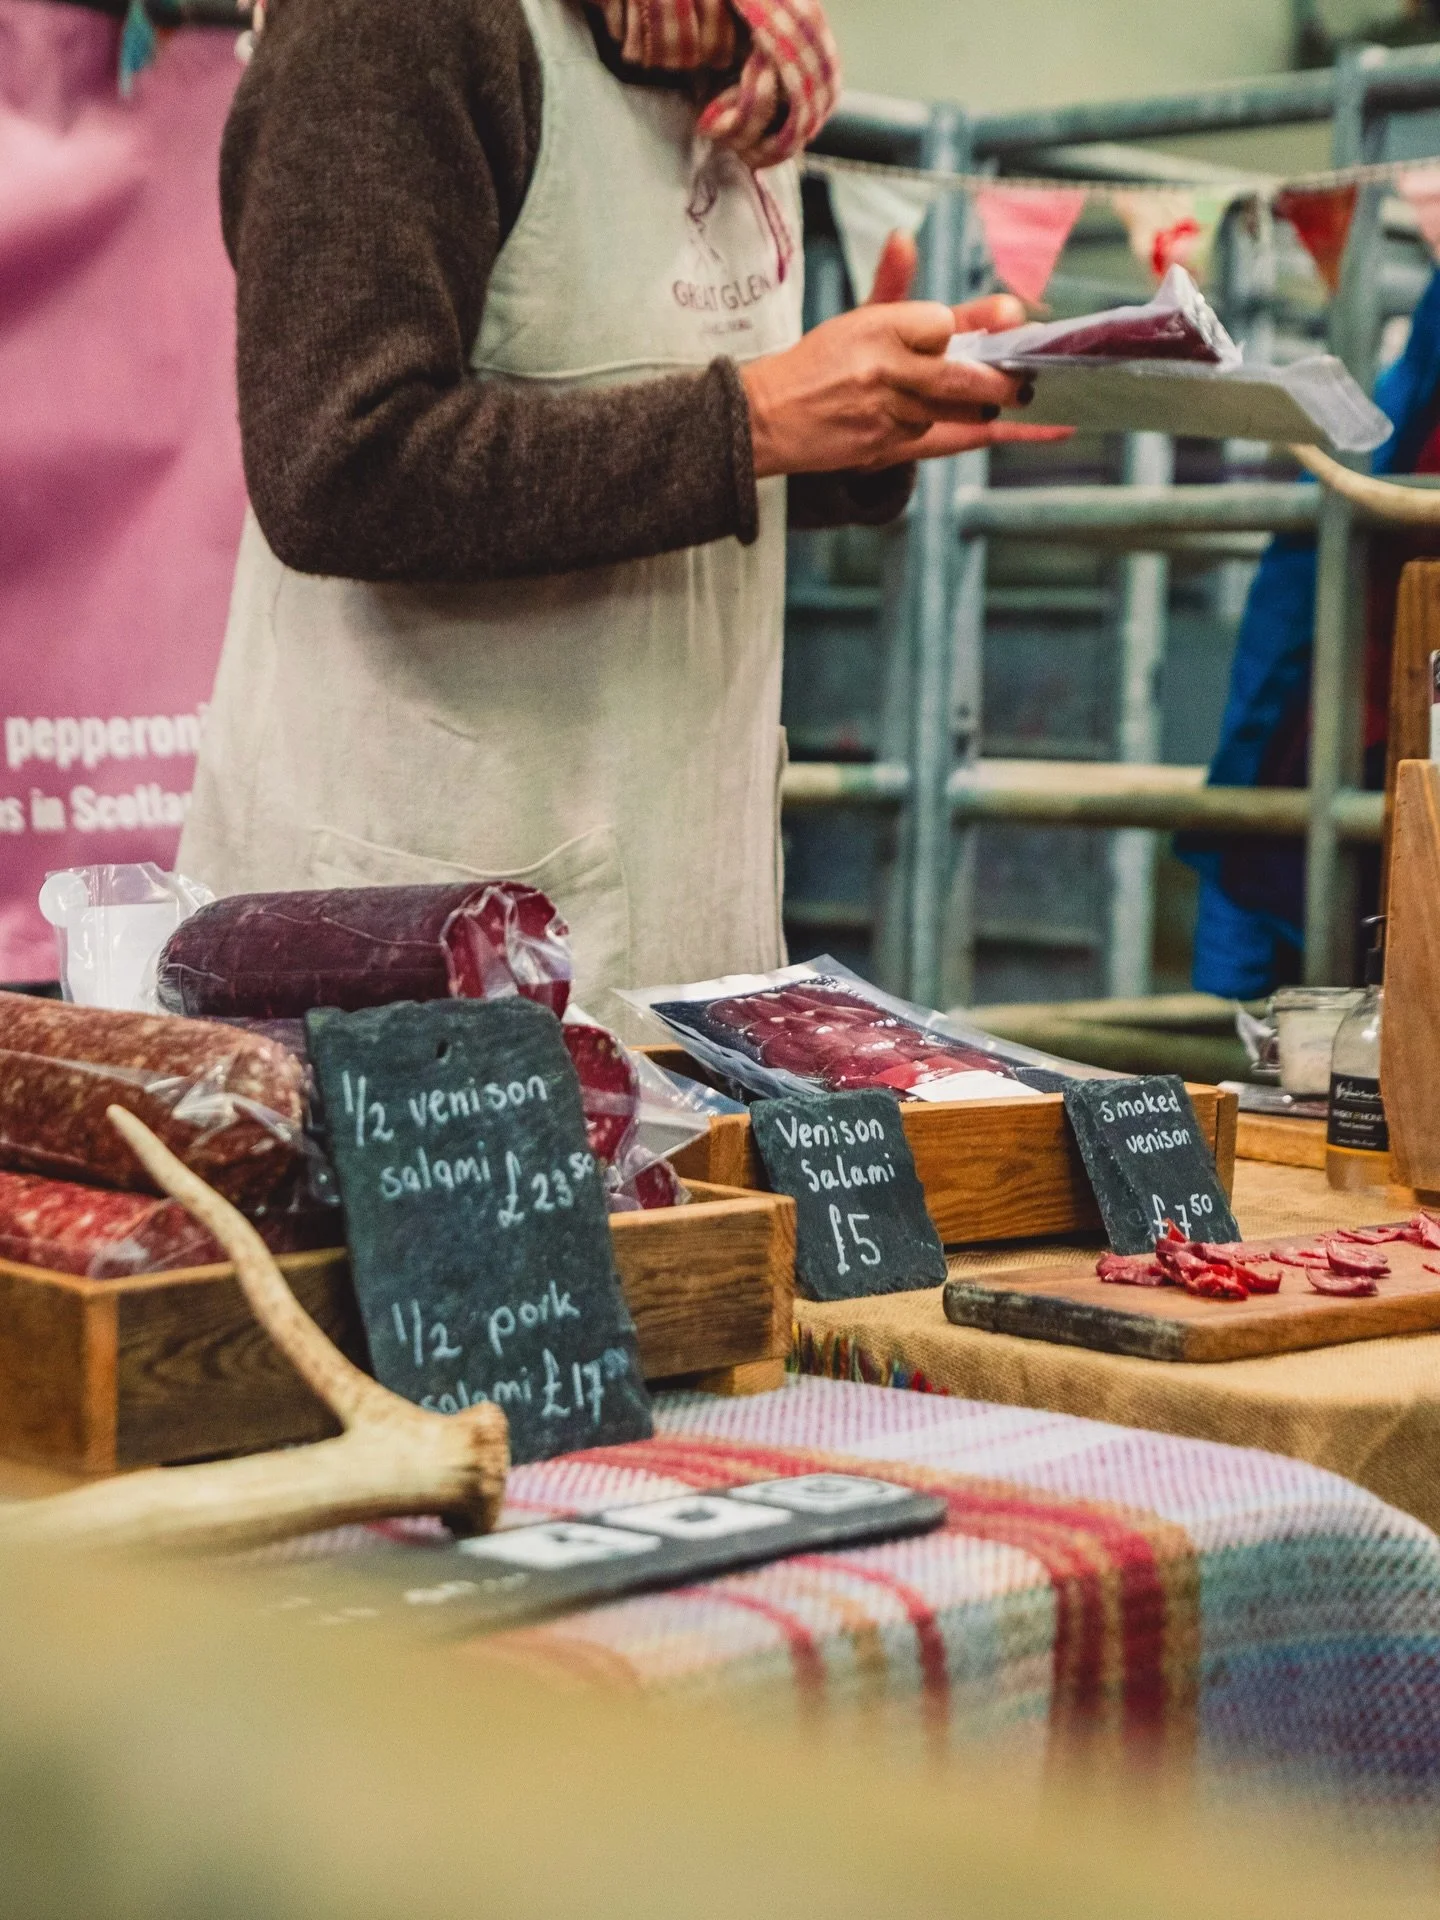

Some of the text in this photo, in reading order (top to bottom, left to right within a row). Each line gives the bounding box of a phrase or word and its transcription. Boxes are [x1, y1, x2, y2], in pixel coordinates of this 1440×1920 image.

[5, 713, 202, 772] pepperon
[29, 786, 67, 834] in
[342, 1070, 549, 1148] 1/2 venison
[775, 1115, 885, 1149] Venison
[380, 1140, 492, 1200] salami
[1125, 1127, 1193, 1154] venison
[828, 1203, 882, 1276] £5
[391, 1279, 581, 1368] 1/2 pork
